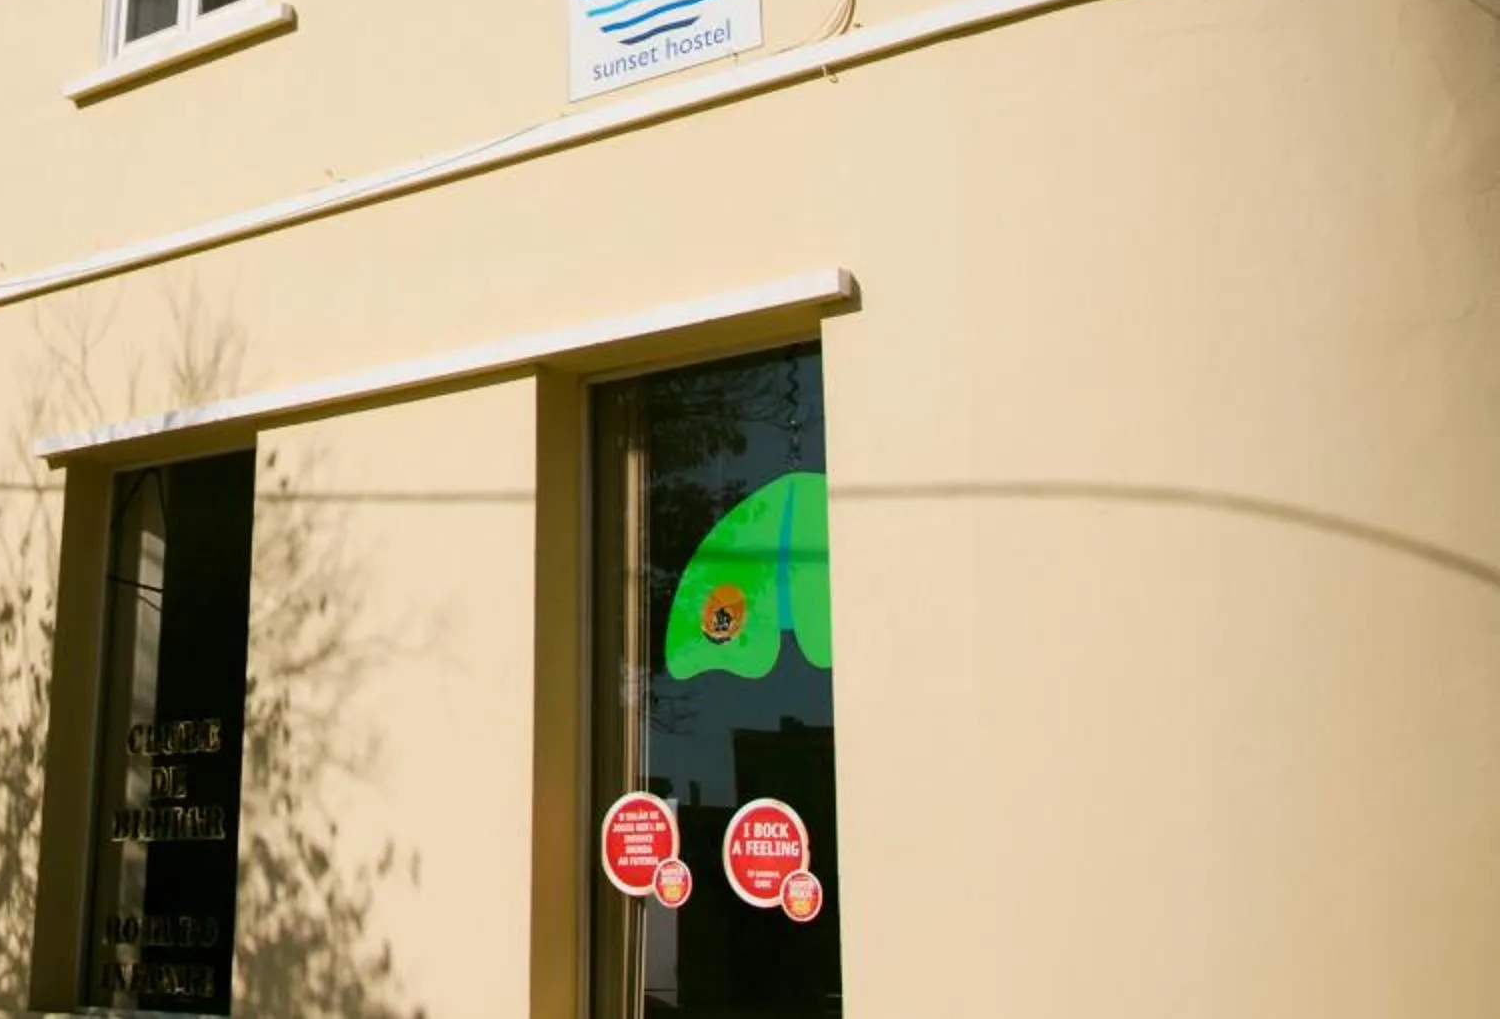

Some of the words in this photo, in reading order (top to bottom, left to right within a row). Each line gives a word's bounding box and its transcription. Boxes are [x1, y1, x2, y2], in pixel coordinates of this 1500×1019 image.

[592, 45, 659, 82] sunset
[665, 18, 732, 60] hostel
[743, 822, 751, 838] I
[753, 822, 789, 838] BOCK
[731, 840, 742, 856] A
[745, 841, 799, 857] FEELING
